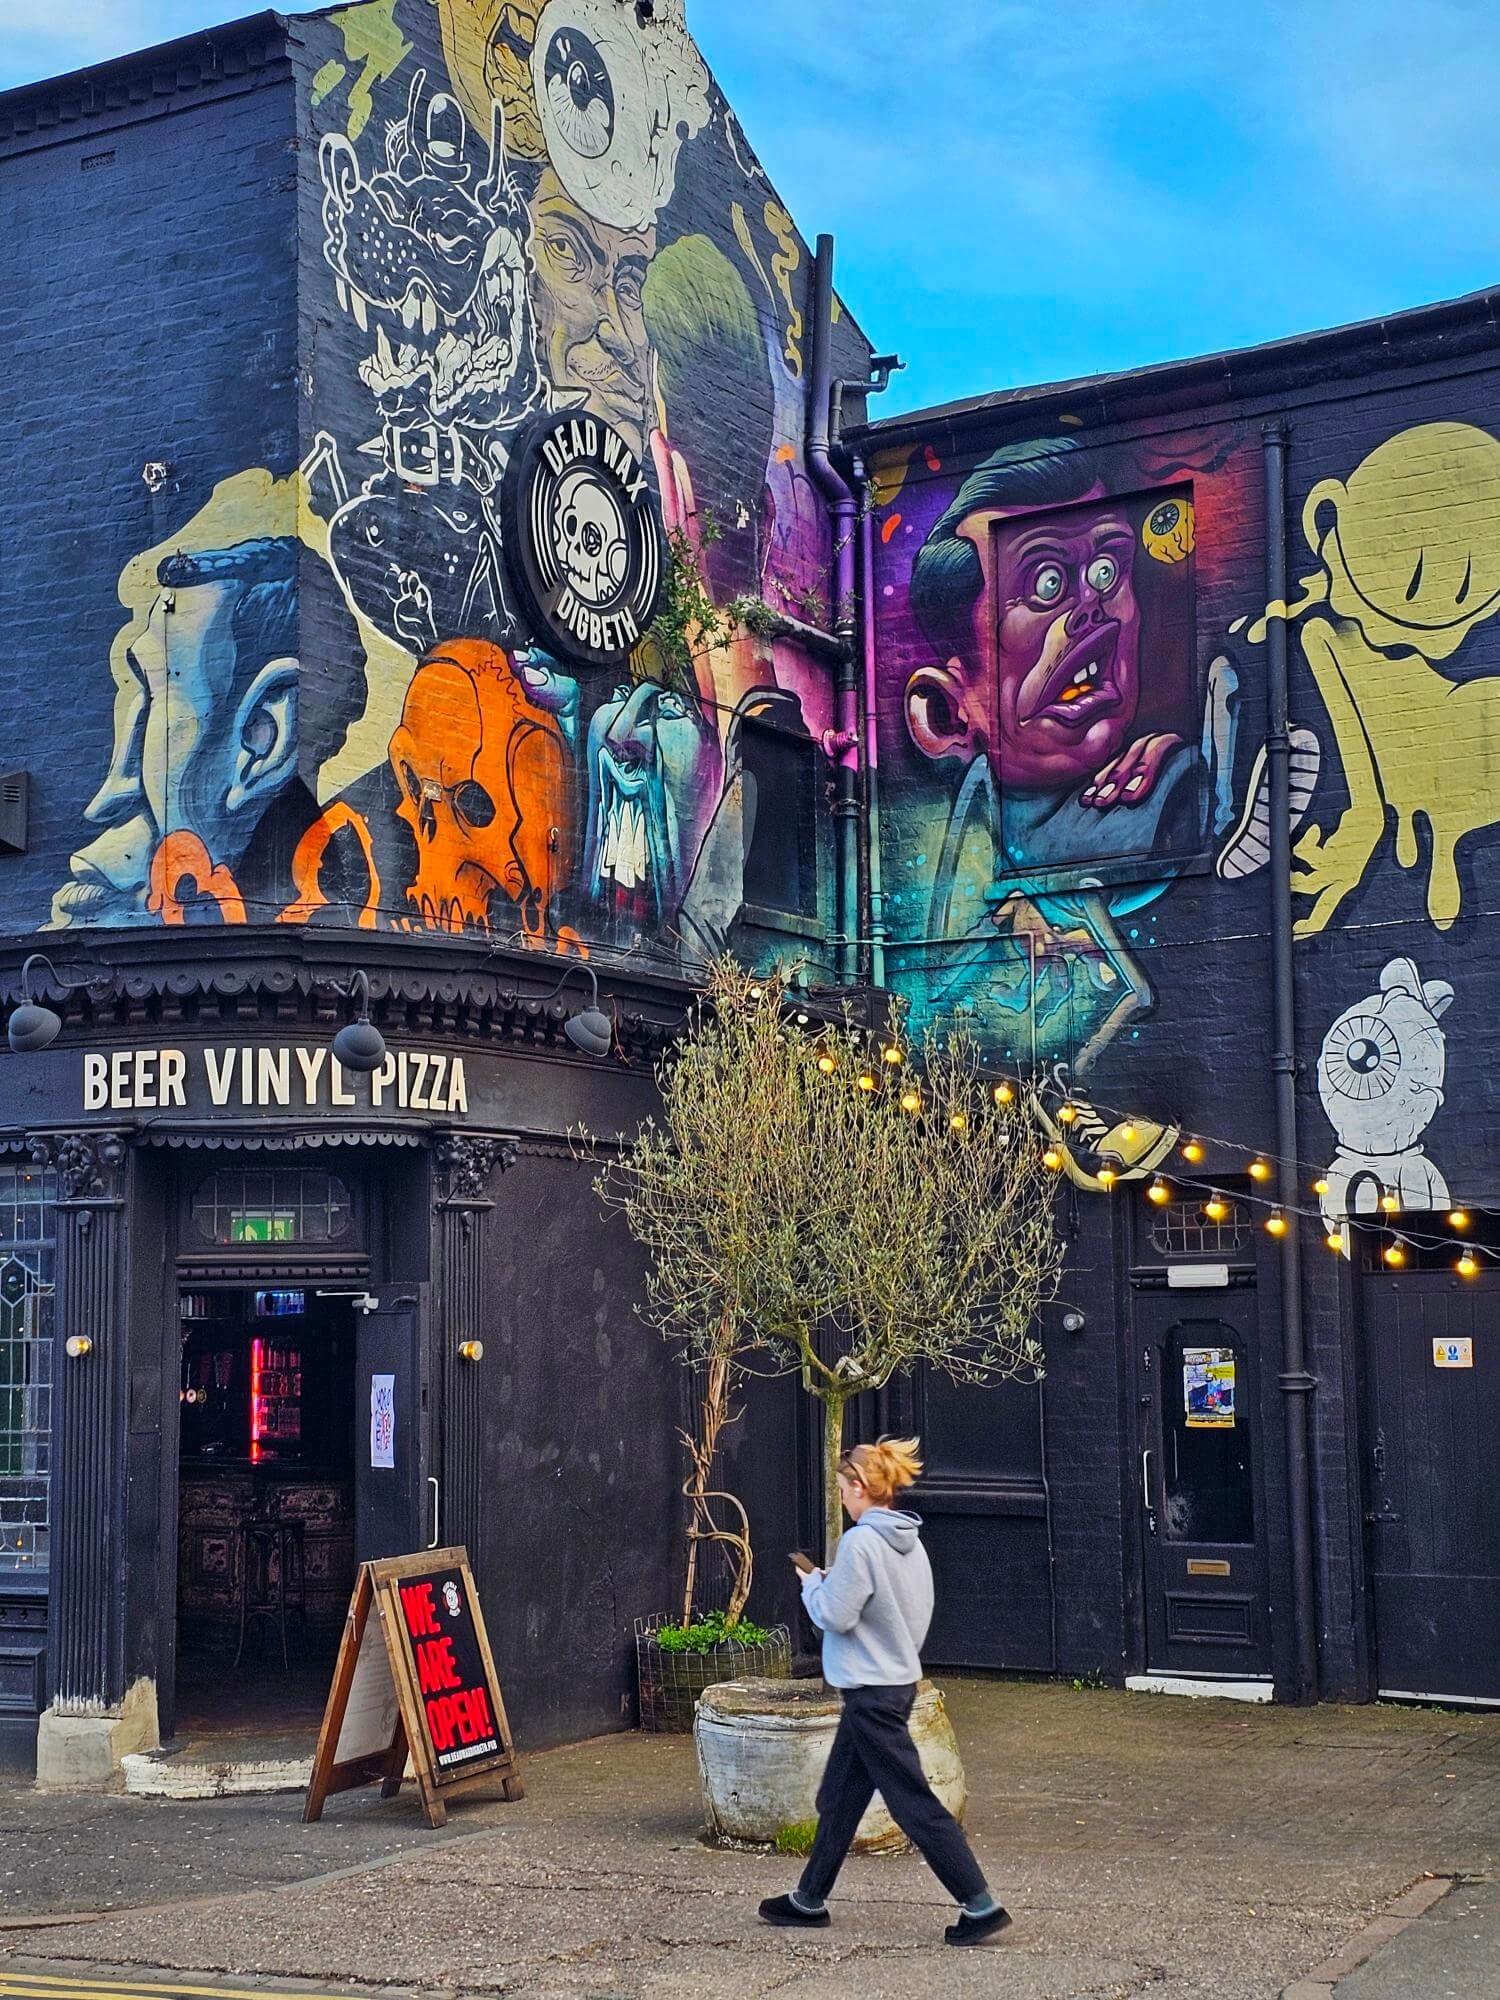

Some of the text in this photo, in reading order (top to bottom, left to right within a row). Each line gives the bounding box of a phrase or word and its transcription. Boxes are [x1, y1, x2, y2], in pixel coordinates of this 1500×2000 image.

[542, 419, 648, 504] DEAD WAX
[556, 586, 639, 651] DIGBETH
[84, 1047, 468, 1113] BEER VINYL PIZZA
[401, 1583, 441, 1636] WE
[416, 1637, 462, 1694] ARE
[426, 1688, 494, 1750] OPEN!
